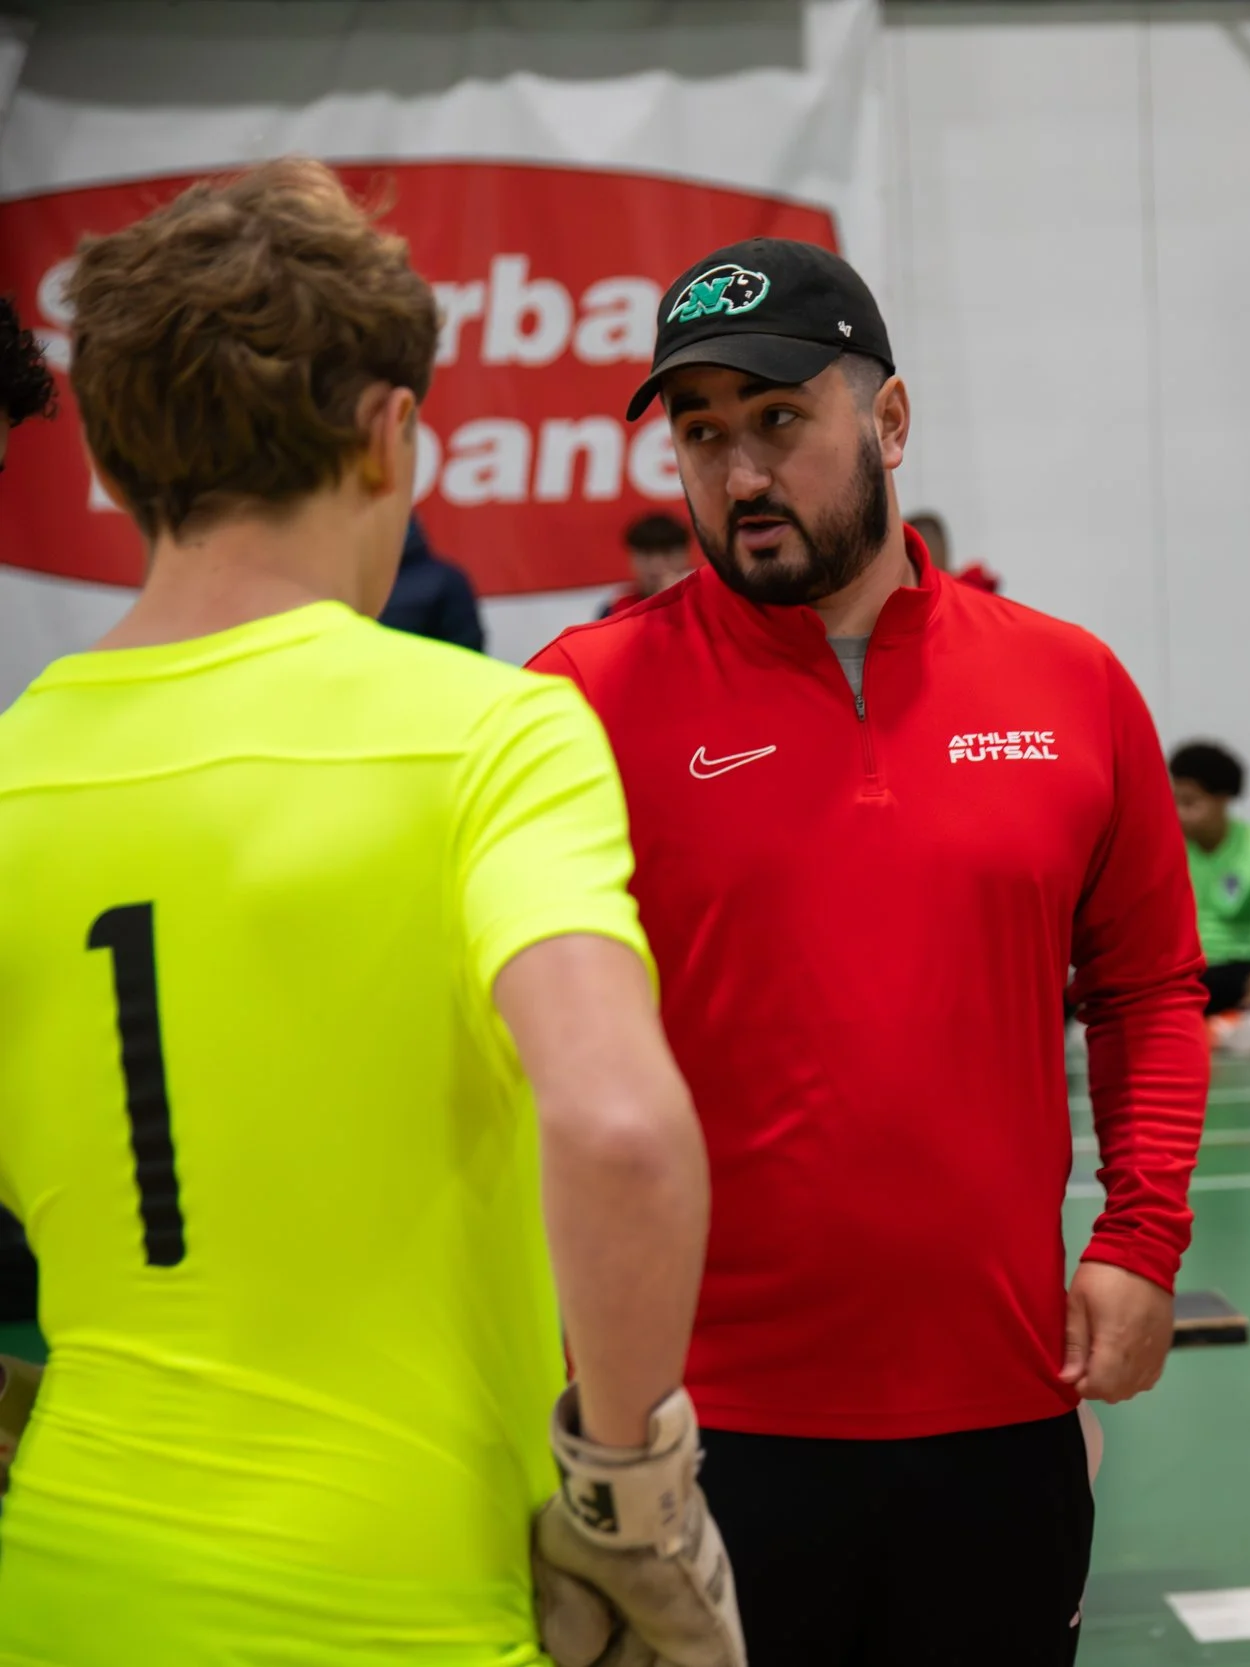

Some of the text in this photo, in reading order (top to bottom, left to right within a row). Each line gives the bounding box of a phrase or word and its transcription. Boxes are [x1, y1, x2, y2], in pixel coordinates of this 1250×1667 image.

[948, 731, 1056, 749] ATHLETIC
[948, 744, 1059, 764] FUTSAL
[85, 899, 187, 1268] 1
